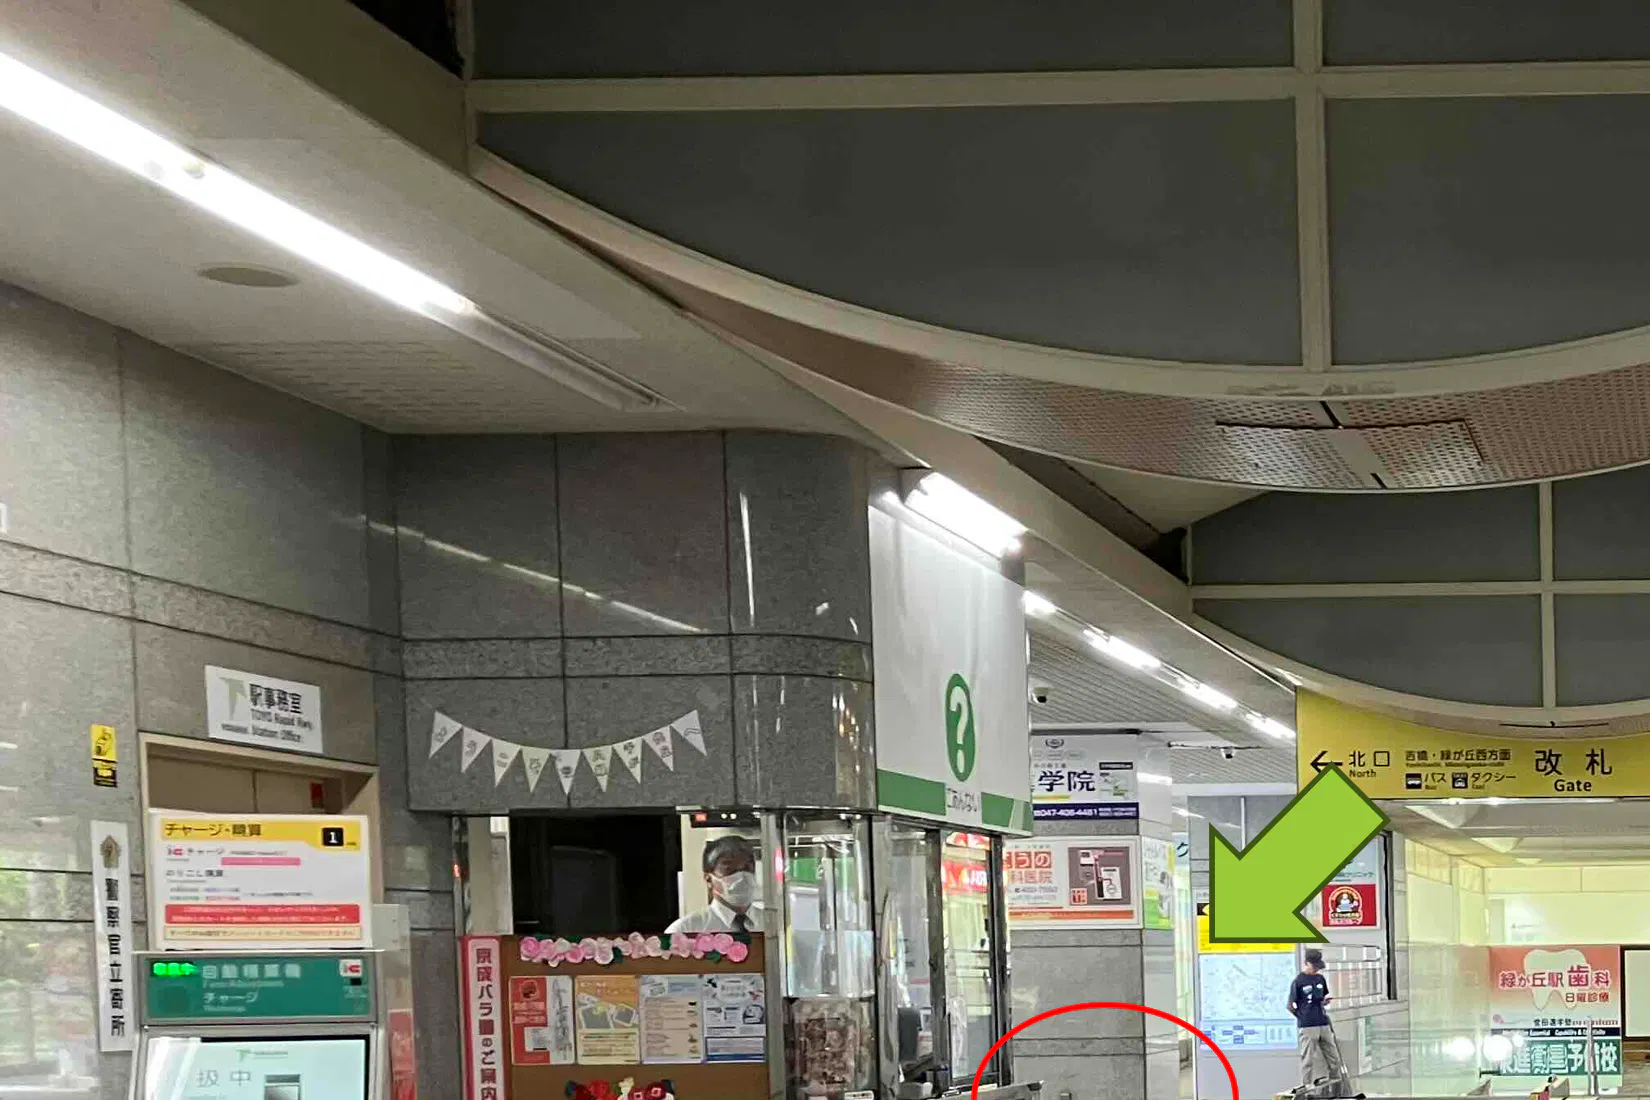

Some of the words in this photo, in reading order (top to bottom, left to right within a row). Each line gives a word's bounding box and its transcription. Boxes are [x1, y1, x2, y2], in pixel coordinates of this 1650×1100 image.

[1349, 750, 1391, 768] 北口
[1534, 748, 1613, 777] 改札
[1031, 770, 1096, 792] 学院
[1349, 769, 1377, 779] North
[1424, 772, 1448, 784] バス
[1470, 772, 1517, 784] タクシー
[1553, 779, 1593, 793] Gate
[946, 787, 979, 812] ごあんない
[1500, 964, 1610, 989] 緑が丘駅歯科
[1565, 992, 1610, 1003] 日曜診療
